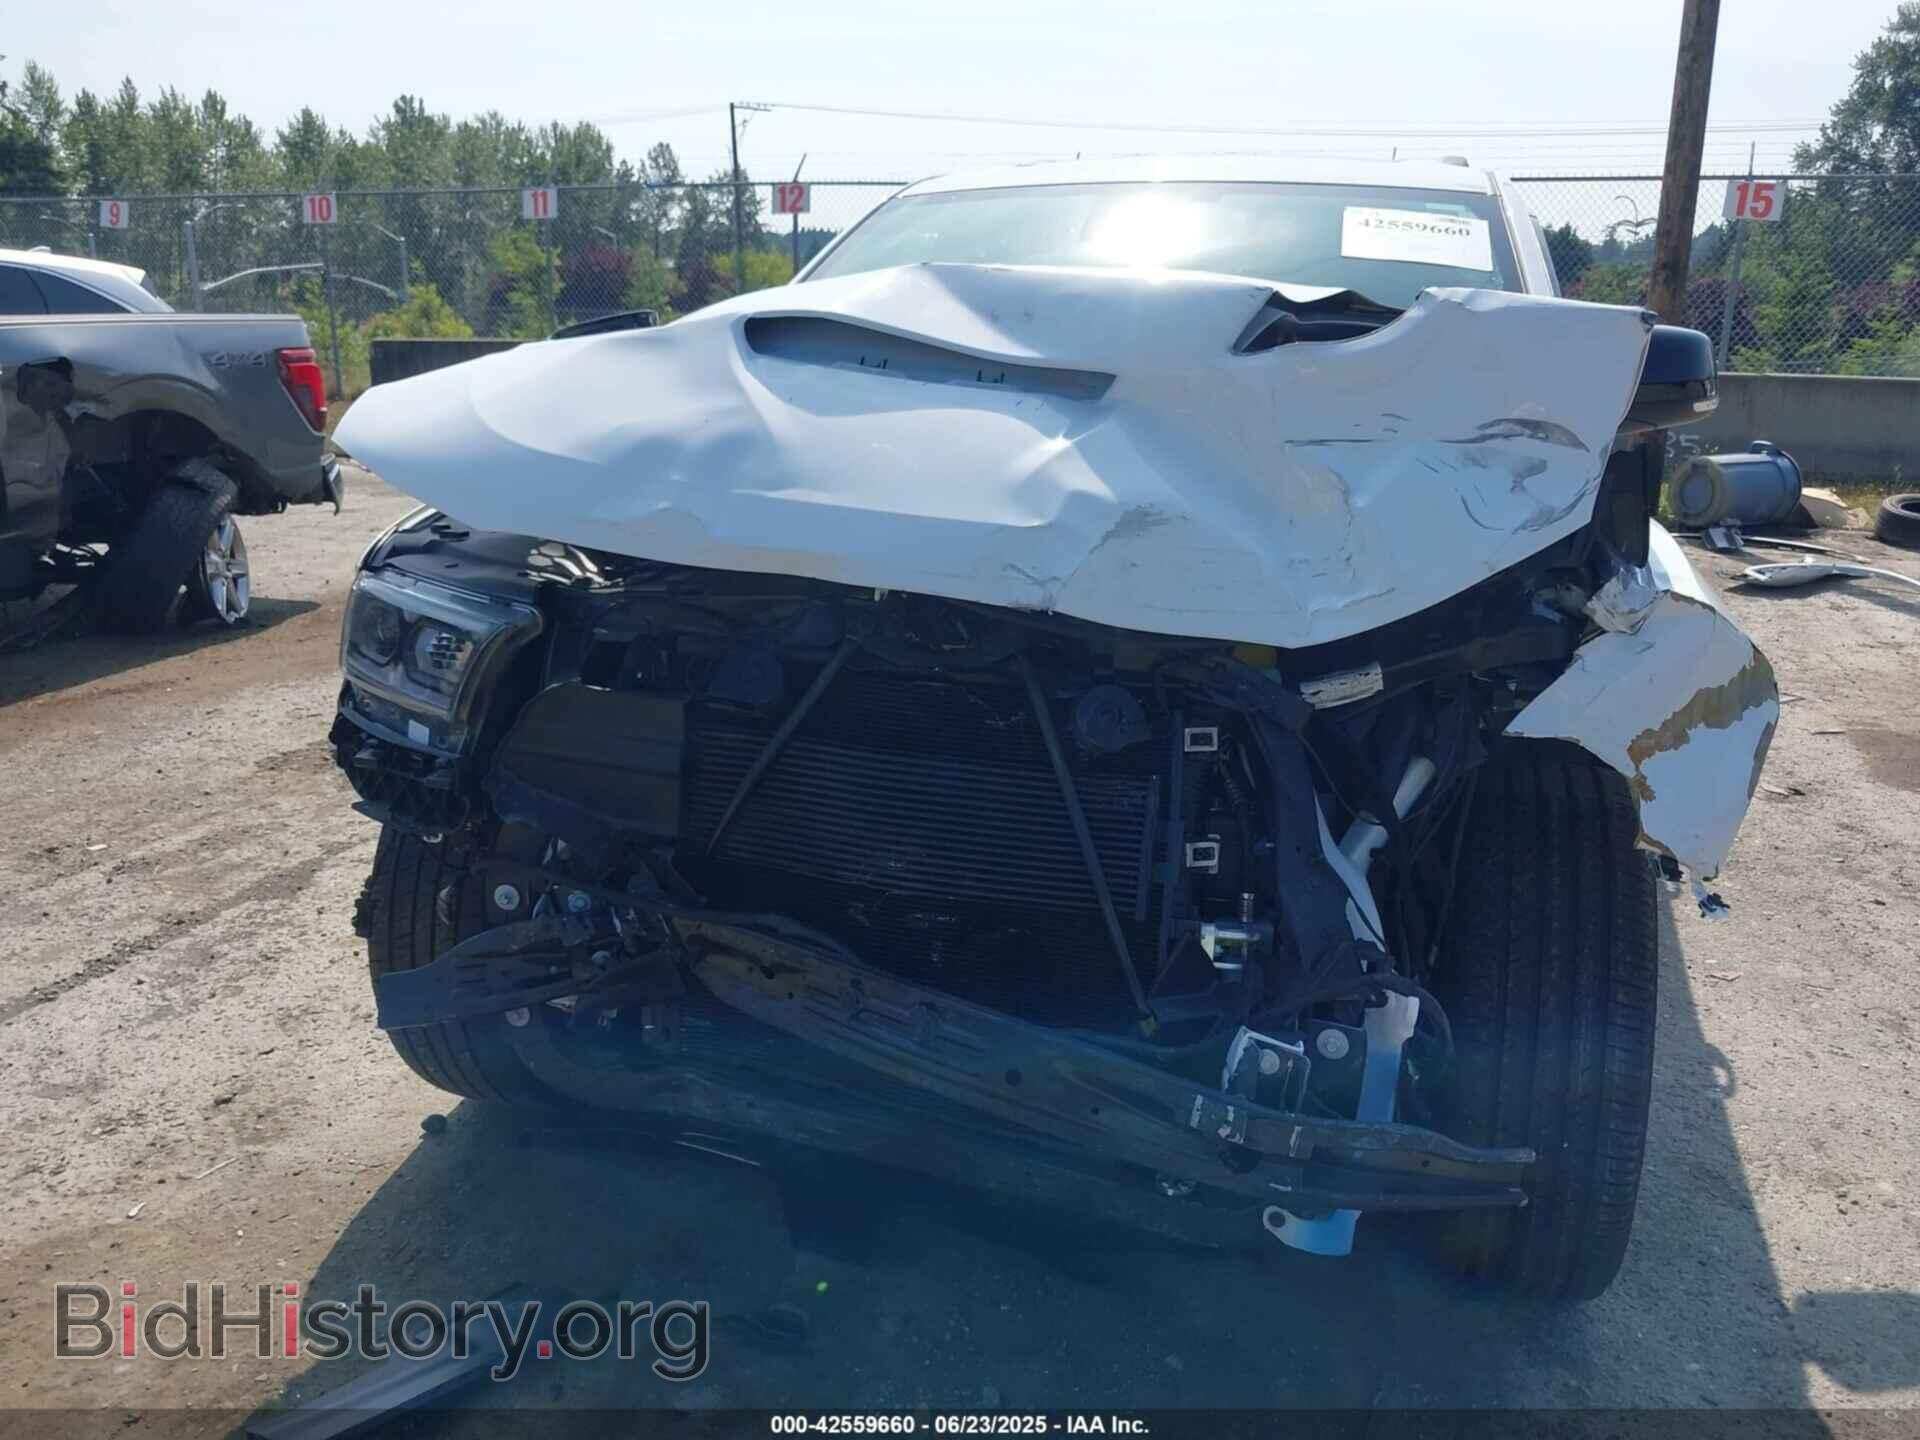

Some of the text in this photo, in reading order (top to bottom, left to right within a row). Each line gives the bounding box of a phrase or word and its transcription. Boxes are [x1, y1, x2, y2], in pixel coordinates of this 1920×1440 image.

[308, 196, 332, 221] 10
[531, 190, 549, 217] 11
[778, 184, 805, 212] 12
[1736, 182, 1776, 218] 15
[110, 202, 121, 225] 9
[1358, 218, 1471, 237] 42559660
